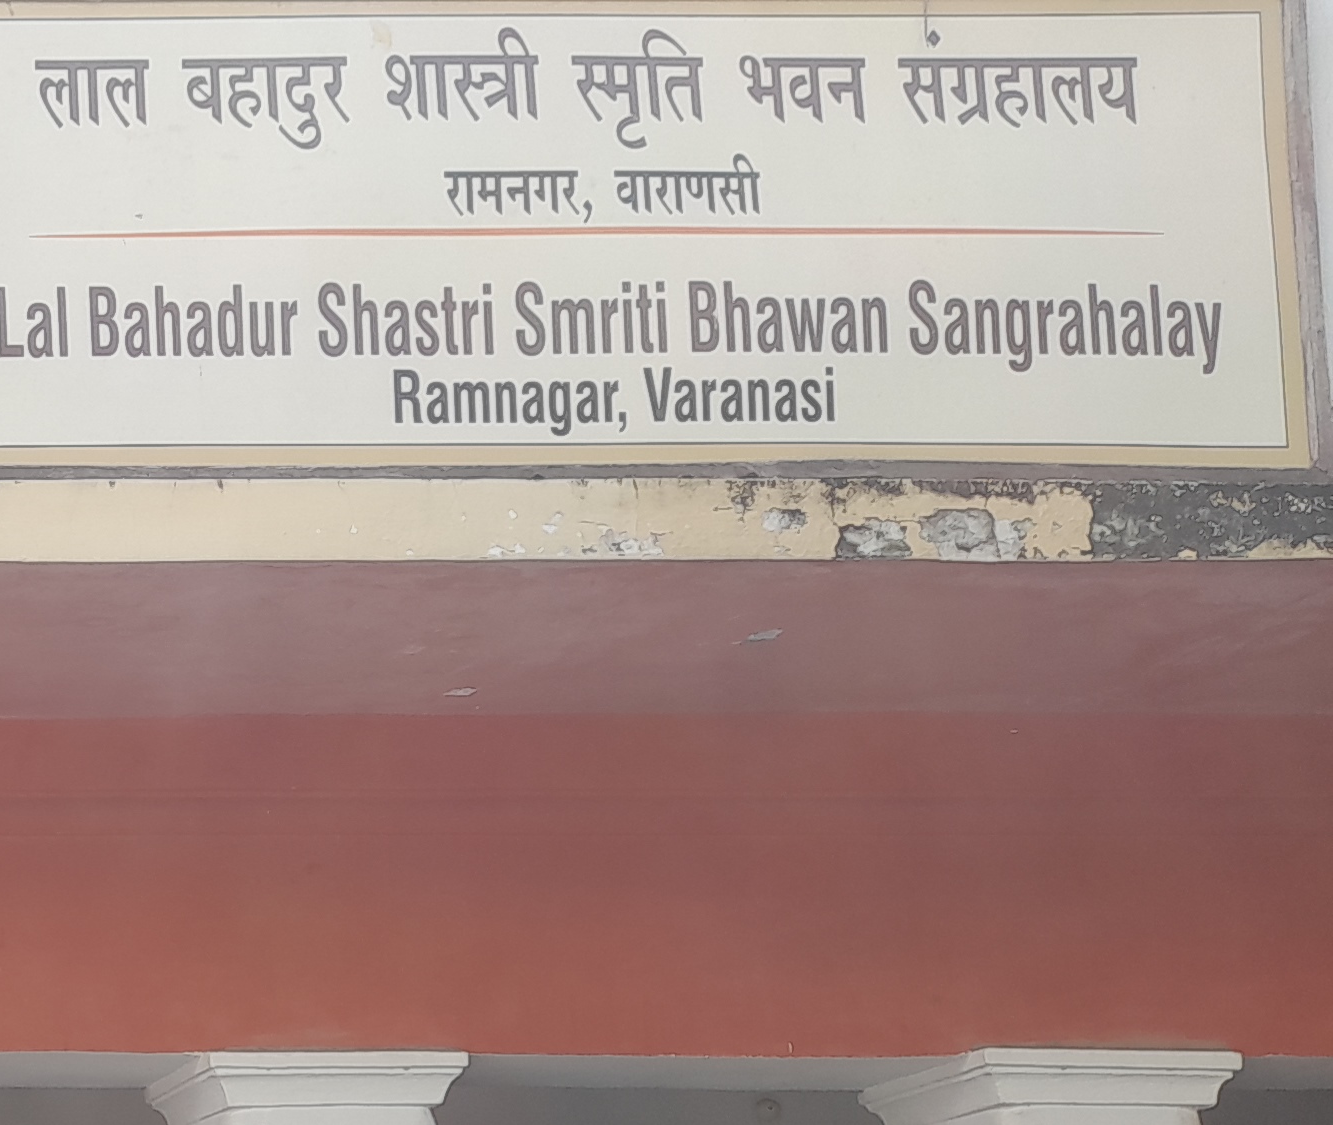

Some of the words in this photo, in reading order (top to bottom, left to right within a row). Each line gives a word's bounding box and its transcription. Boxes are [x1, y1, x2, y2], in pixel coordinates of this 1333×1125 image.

[35, 60, 149, 128] लाल
[182, 56, 349, 149] बहादुर
[385, 27, 539, 127] शास्त्री
[572, 29, 703, 149] स्मृति
[739, 55, 865, 123] भवन
[898, 25, 1137, 128] संग्रहालय
[444, 171, 592, 223] रामनगर,
[614, 154, 760, 215] वाराणसी
[89, 285, 297, 358] Bahadur
[318, 283, 494, 357] Shastri
[516, 281, 667, 356] Smriti
[689, 281, 888, 353] Bhawan
[909, 280, 1221, 374] Sangrahalay
[394, 370, 626, 436] Ramnagar,
[643, 367, 835, 422] Varanasi
